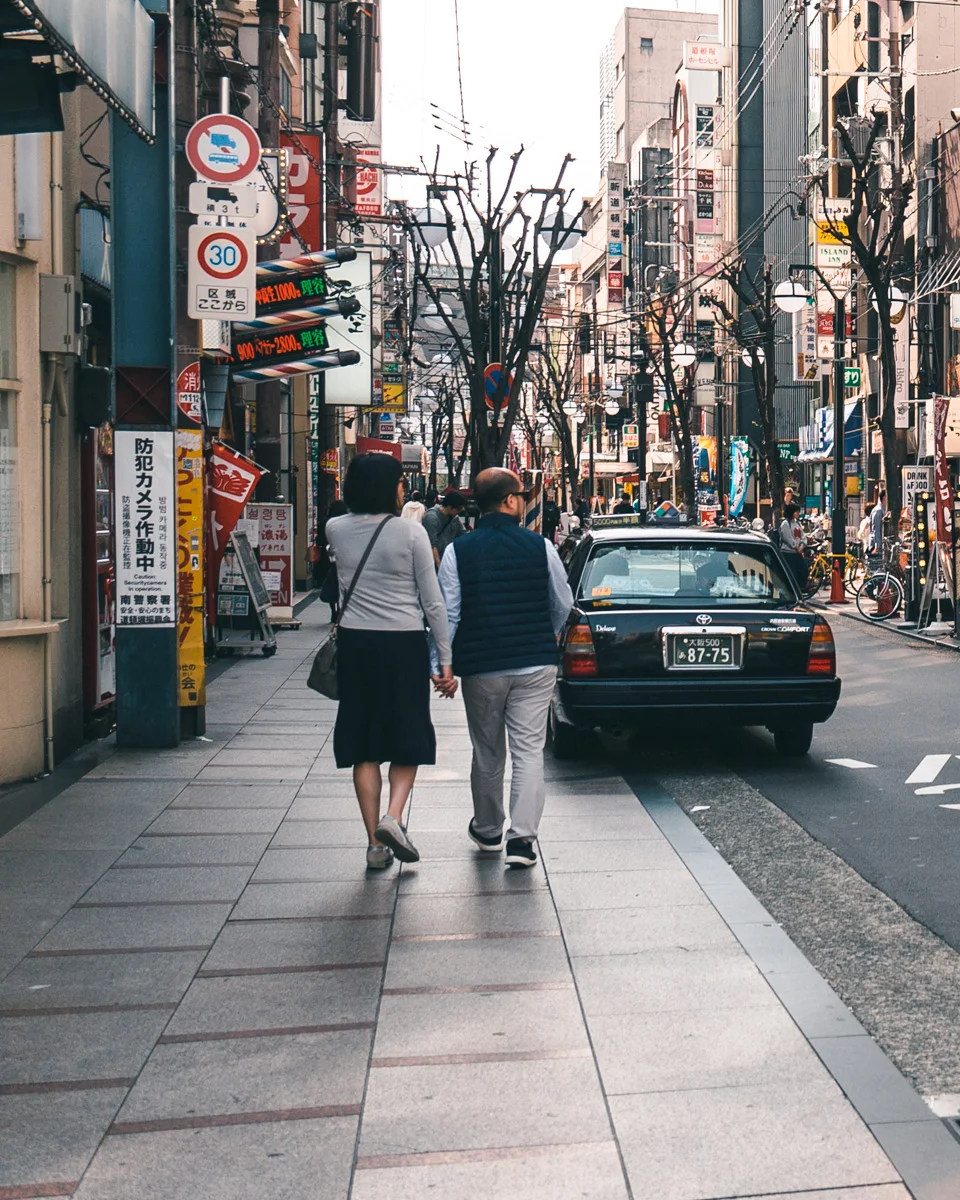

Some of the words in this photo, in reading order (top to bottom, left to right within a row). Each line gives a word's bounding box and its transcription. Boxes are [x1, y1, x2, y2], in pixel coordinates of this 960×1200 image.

[209, 245, 236, 267] 30
[208, 289, 237, 299] 区域
[301, 277, 324, 297] 理容
[198, 298, 246, 312] ここから
[301, 329, 324, 348] 理容
[896, 367, 905, 393] Bistro
[134, 438, 154, 573] 防犯カメラ作動中
[249, 509, 287, 521] 설렁탕
[120, 595, 171, 605] 南警察署
[120, 607, 171, 615] 安全・安心のまち
[596, 624, 616, 632] Deluxe
[678, 651, 686, 660] あ
[687, 647, 730, 663] 87-75
[182, 676, 195, 689] 会
